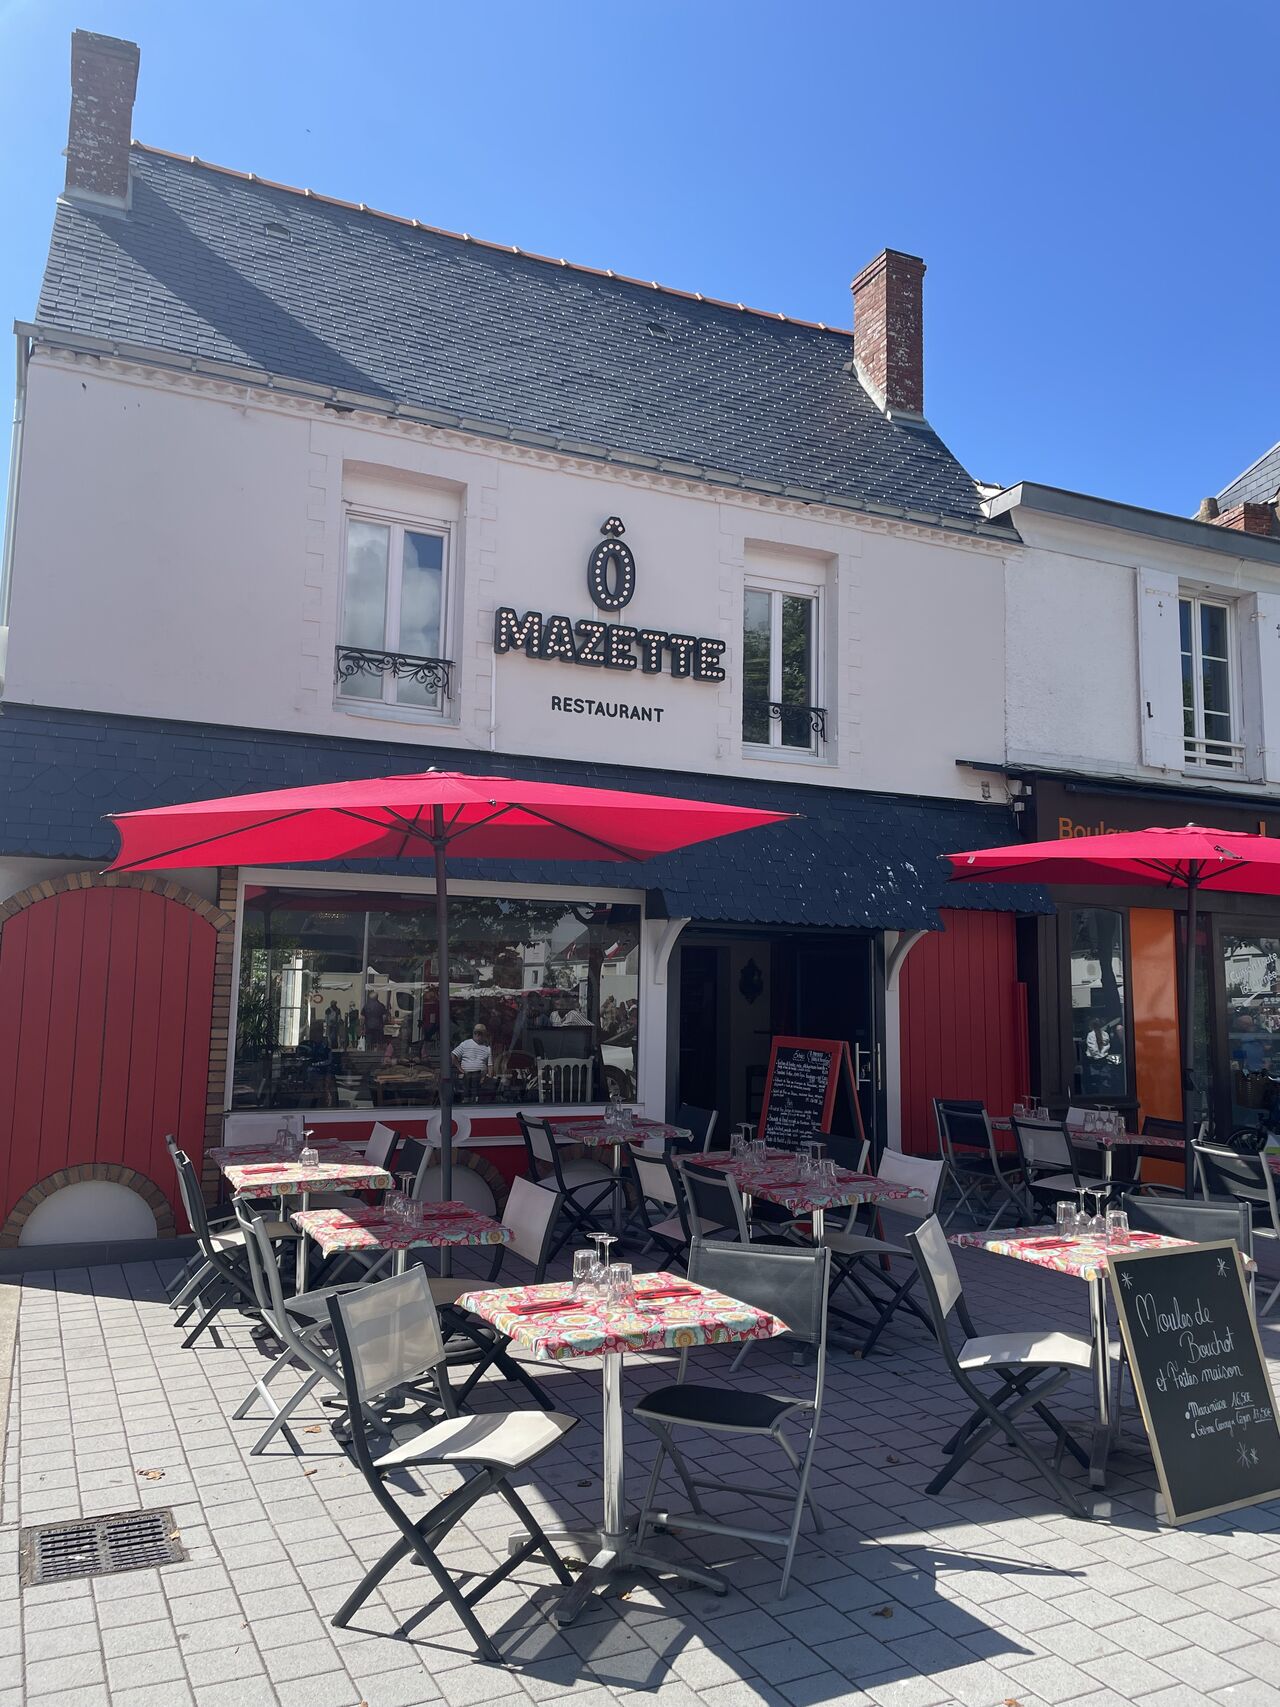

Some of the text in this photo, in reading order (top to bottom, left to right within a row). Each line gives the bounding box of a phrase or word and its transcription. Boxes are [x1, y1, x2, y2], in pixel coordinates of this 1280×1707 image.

[494, 606, 726, 682] MAZETTE
[551, 695, 664, 723] RESTAURANT
[1136, 1293, 1214, 1337] Moules de
[1179, 1326, 1235, 1364] Bouchot
[1156, 1360, 1244, 1392] et Frites maison
